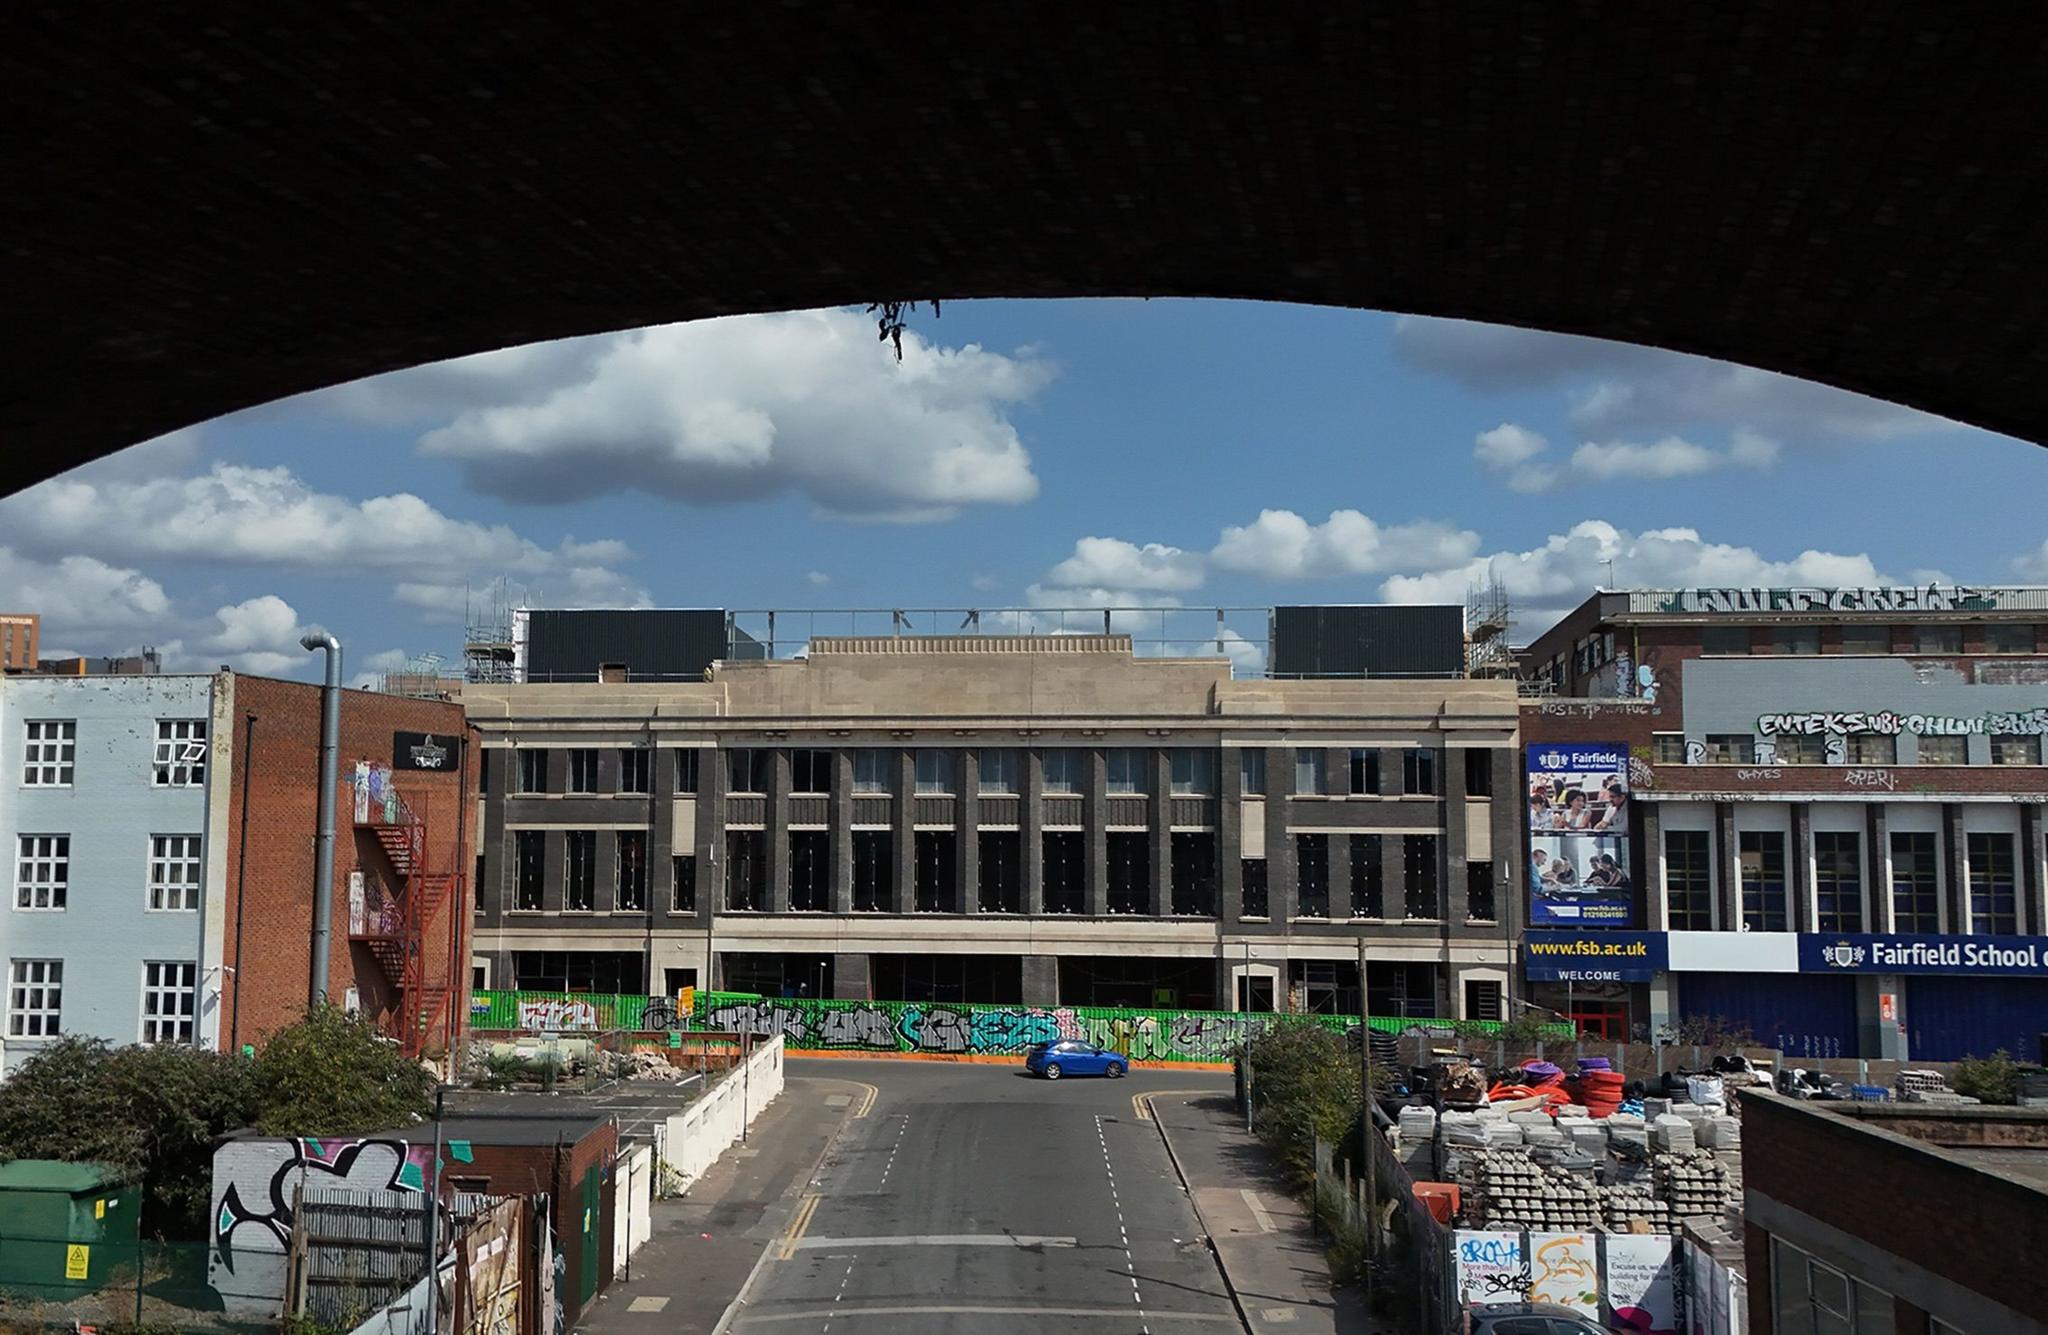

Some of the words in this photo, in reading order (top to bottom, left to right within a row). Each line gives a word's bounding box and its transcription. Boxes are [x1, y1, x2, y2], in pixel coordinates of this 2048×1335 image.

[1572, 752, 1617, 763] Fairfield
[1530, 941, 1647, 955] www.fsb.ac.uk
[1872, 942, 1960, 966] Fairfield
[1964, 943, 2038, 967] School
[1558, 971, 1620, 980] WELCOME
[1611, 1262, 1636, 1270] Excuse
[1609, 1272, 1639, 1281] building
[1640, 1272, 1650, 1280] for
